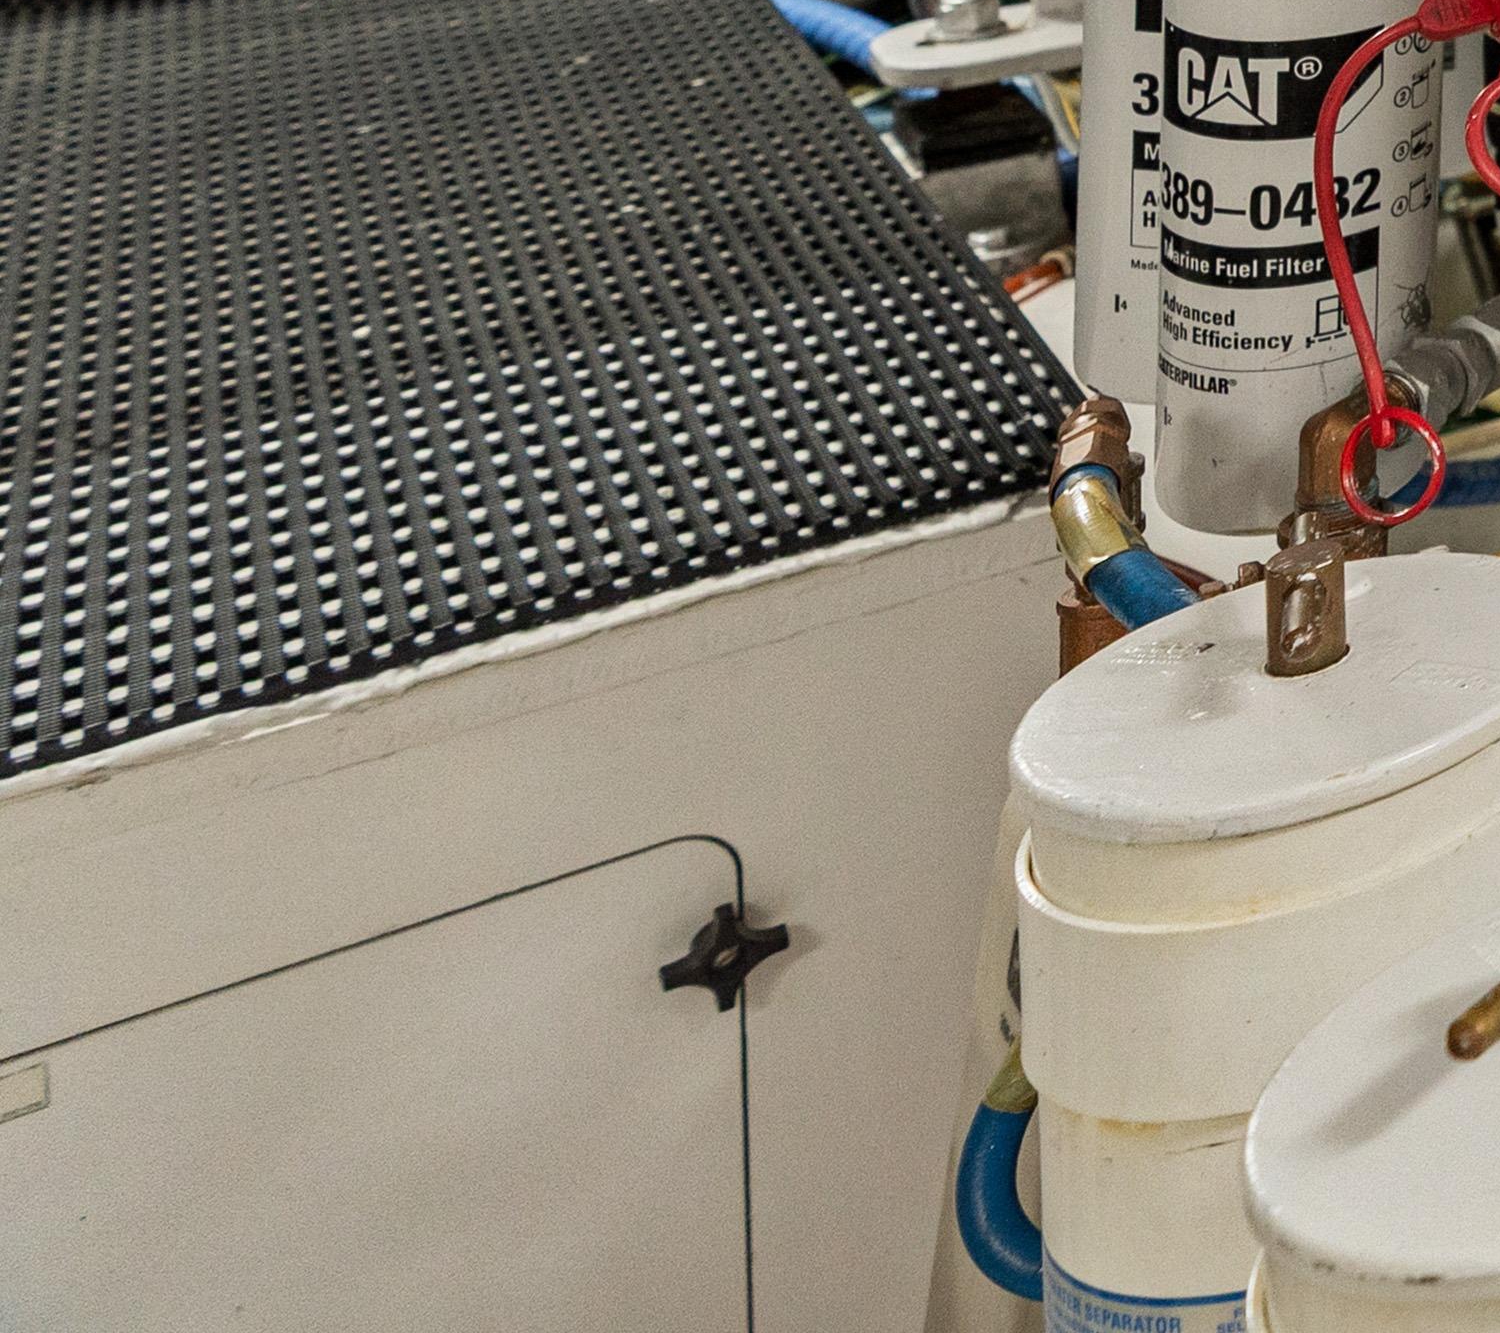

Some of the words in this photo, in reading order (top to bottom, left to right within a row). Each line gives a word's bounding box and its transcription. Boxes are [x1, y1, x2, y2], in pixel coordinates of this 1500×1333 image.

[1163, 235, 1210, 274] Marine
[1215, 257, 1258, 278] Fuel
[1265, 255, 1326, 278] Filter
[1162, 290, 1236, 327] Advanced
[1162, 312, 1188, 343] High
[1191, 327, 1294, 353] Efficiency
